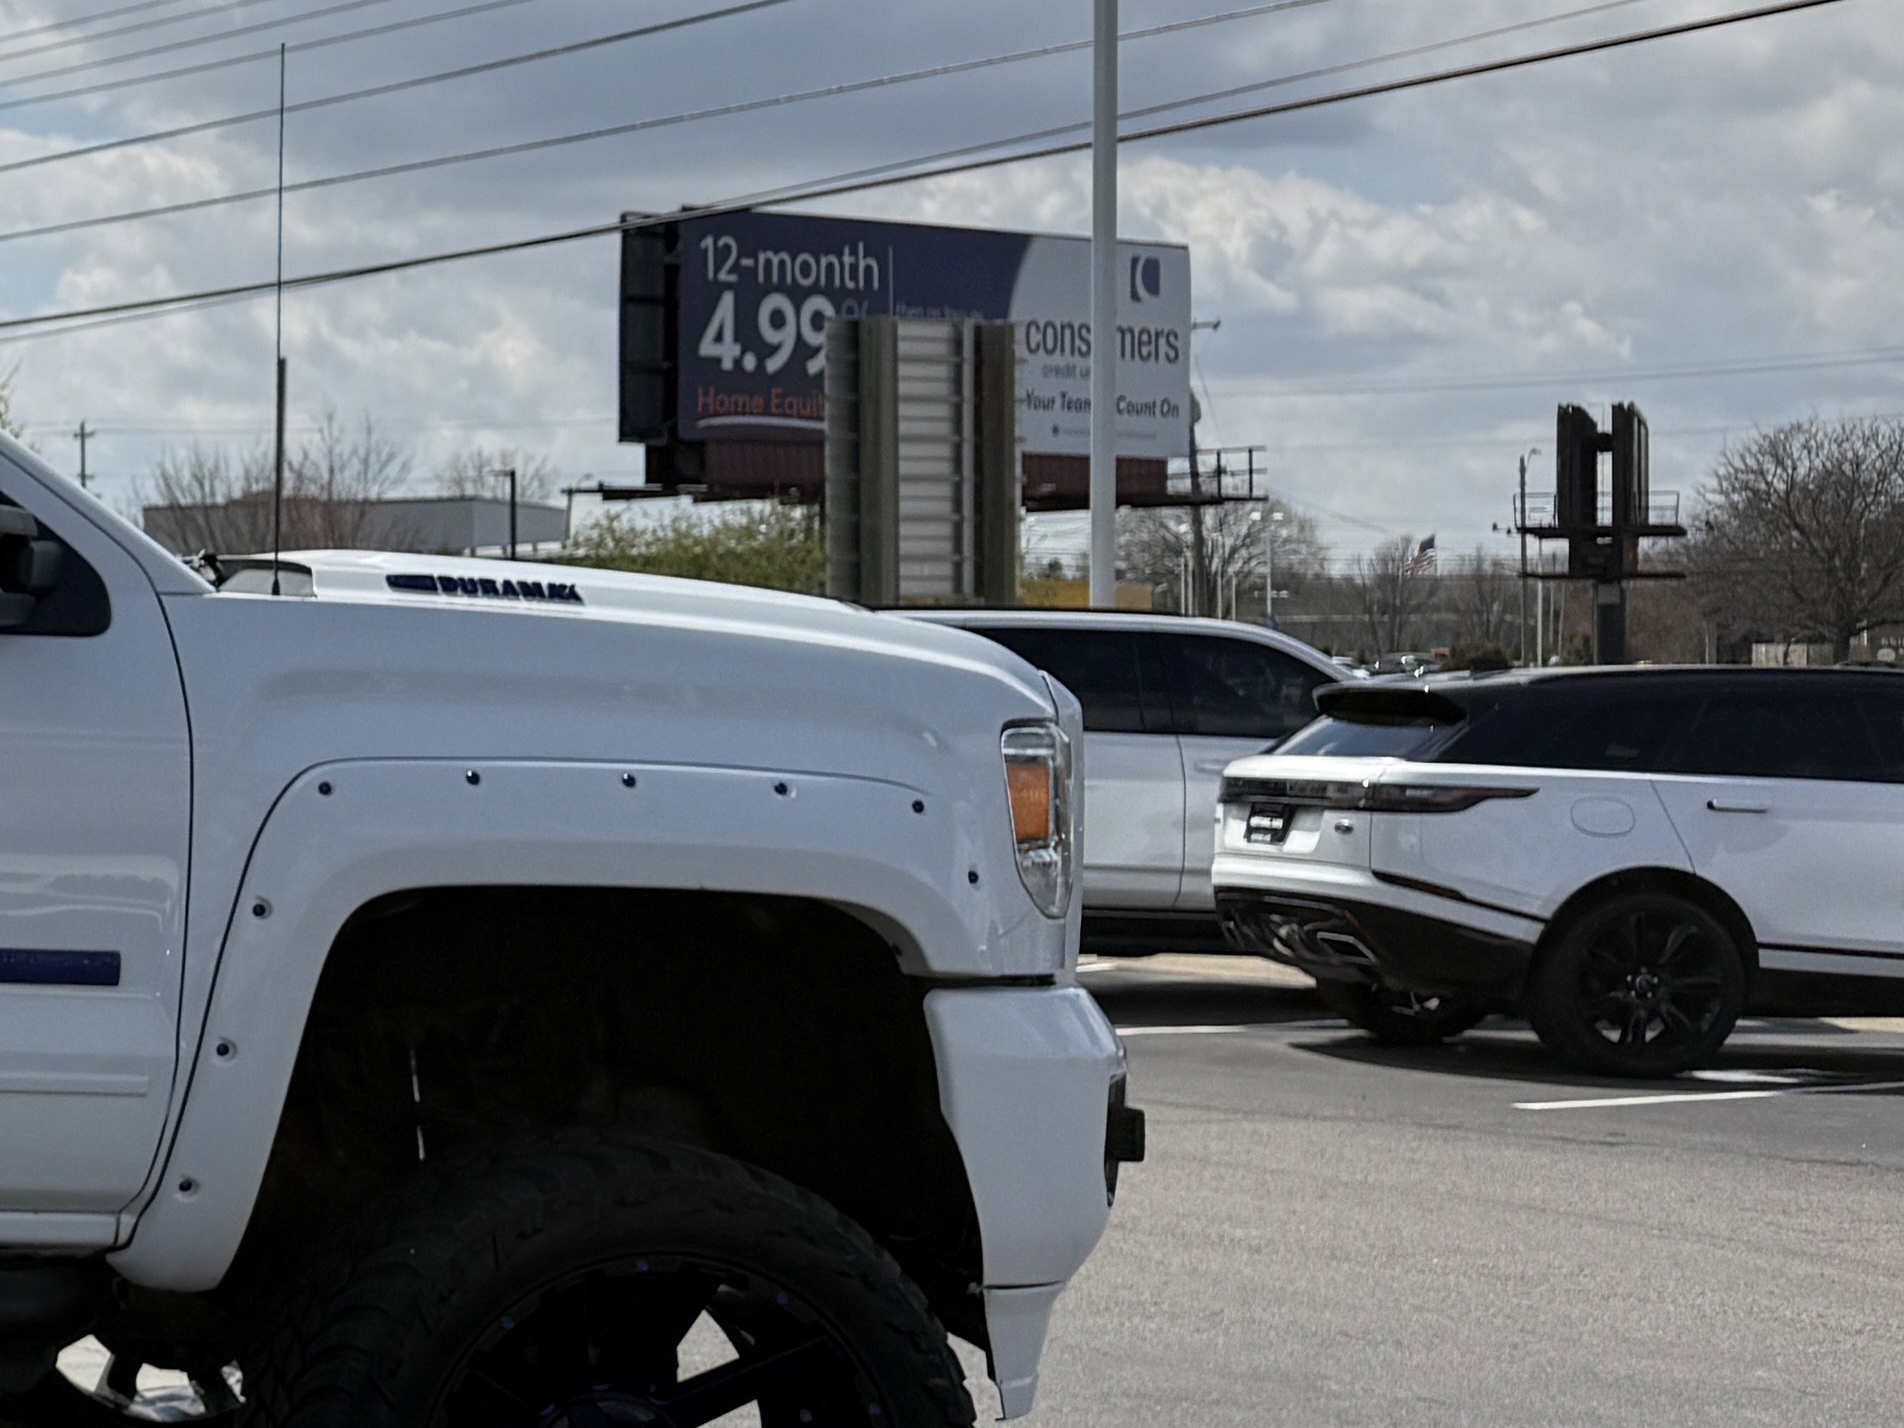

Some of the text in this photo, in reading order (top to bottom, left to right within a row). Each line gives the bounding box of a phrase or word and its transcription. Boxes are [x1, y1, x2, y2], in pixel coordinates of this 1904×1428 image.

[700, 234, 879, 291] 12-month
[1025, 320, 1179, 364] consmers
[697, 386, 765, 415] Home
[1026, 389, 1055, 412] Your
[1116, 394, 1180, 418] Count On
